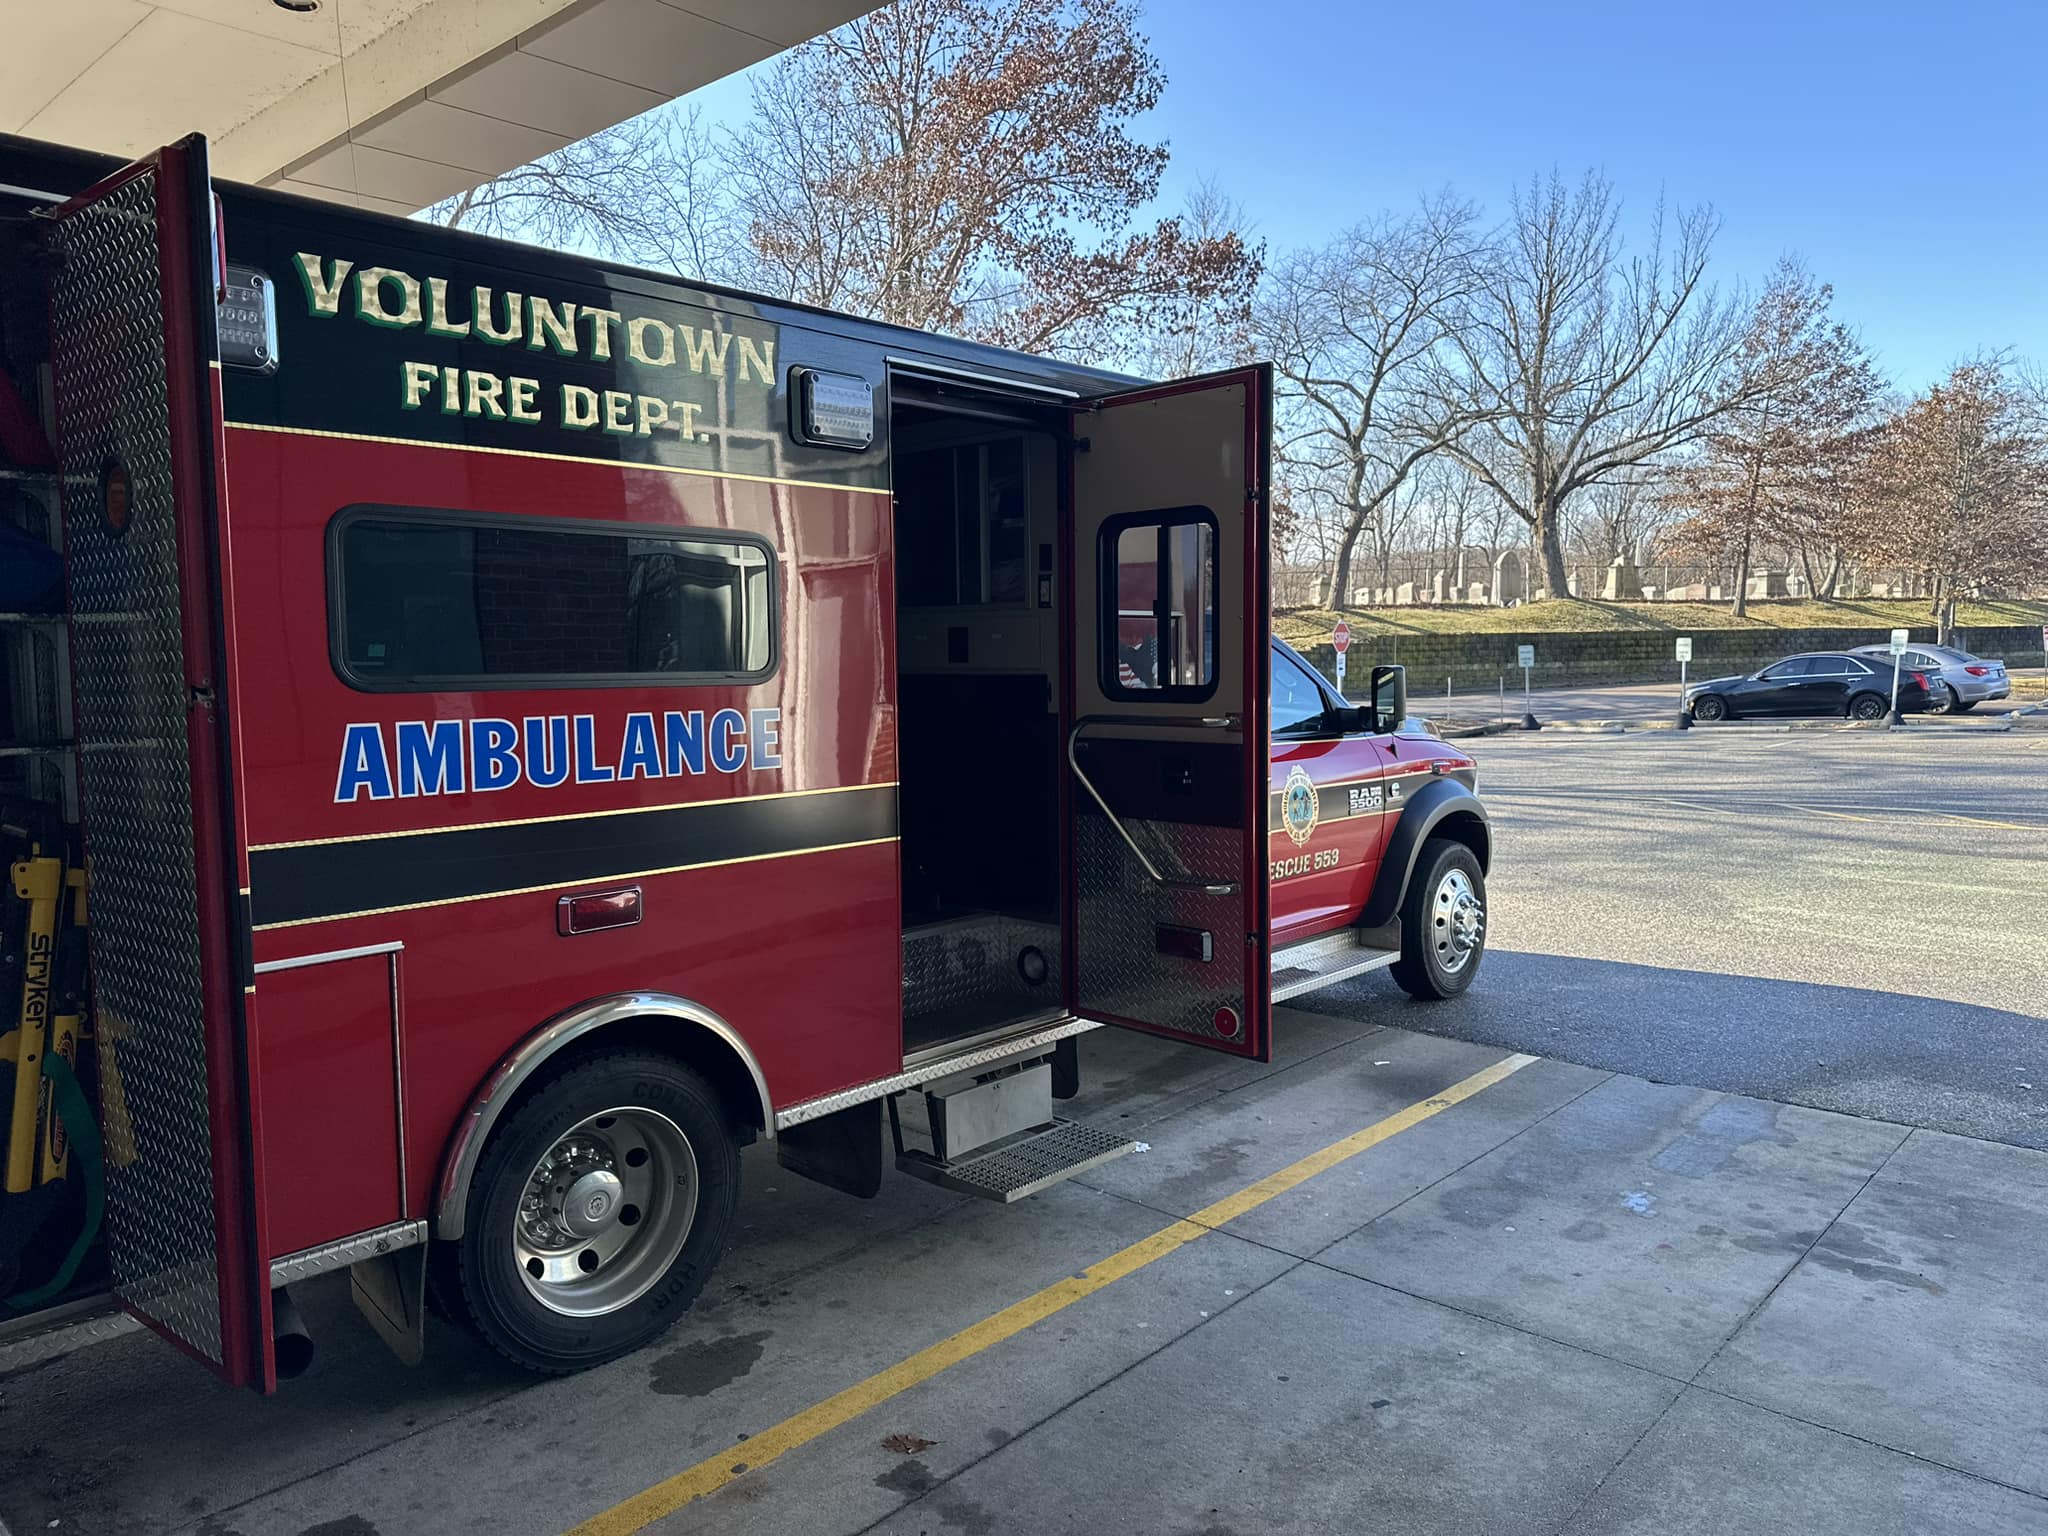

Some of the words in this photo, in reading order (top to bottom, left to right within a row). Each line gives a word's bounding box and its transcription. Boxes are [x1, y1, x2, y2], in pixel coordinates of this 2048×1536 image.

[292, 252, 775, 386] VOLUNTOWN
[400, 361, 542, 423] FIRE
[559, 384, 710, 443] DEPT.
[1334, 631, 1350, 644] STOP
[334, 708, 781, 803] AMBULANCE
[1349, 786, 1382, 799] RAM
[1350, 796, 1382, 809] 5500
[1271, 853, 1312, 880] ESCUE
[25, 931, 53, 1030] stryker
